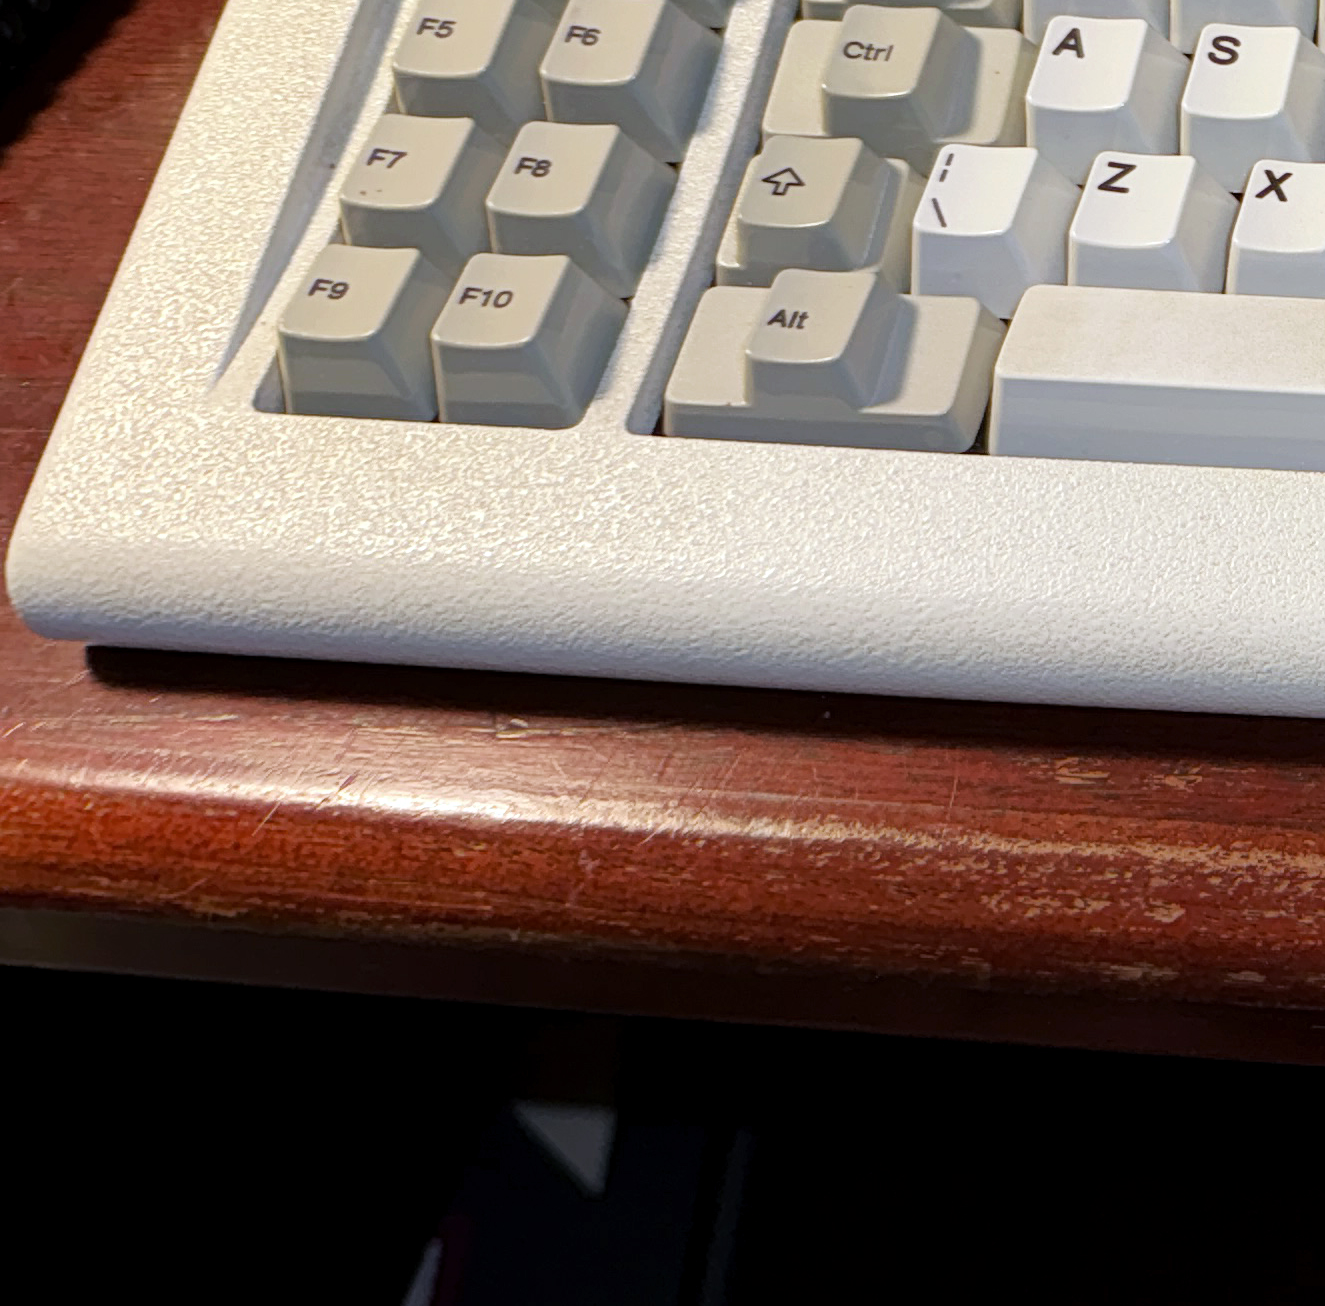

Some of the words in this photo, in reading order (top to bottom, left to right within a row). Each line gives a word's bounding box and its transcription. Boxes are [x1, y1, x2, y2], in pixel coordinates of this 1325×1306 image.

[416, 18, 456, 38] F5
[565, 25, 601, 46] F6
[842, 41, 893, 61] Ctrl
[1051, 28, 1085, 59] A
[1207, 36, 1241, 65] S
[366, 148, 407, 168] F7
[514, 157, 552, 177] F8
[1097, 161, 1137, 194] Z
[1255, 169, 1293, 202] X
[308, 279, 349, 300] F9
[459, 287, 513, 308] F10
[767, 309, 809, 329] Alt
